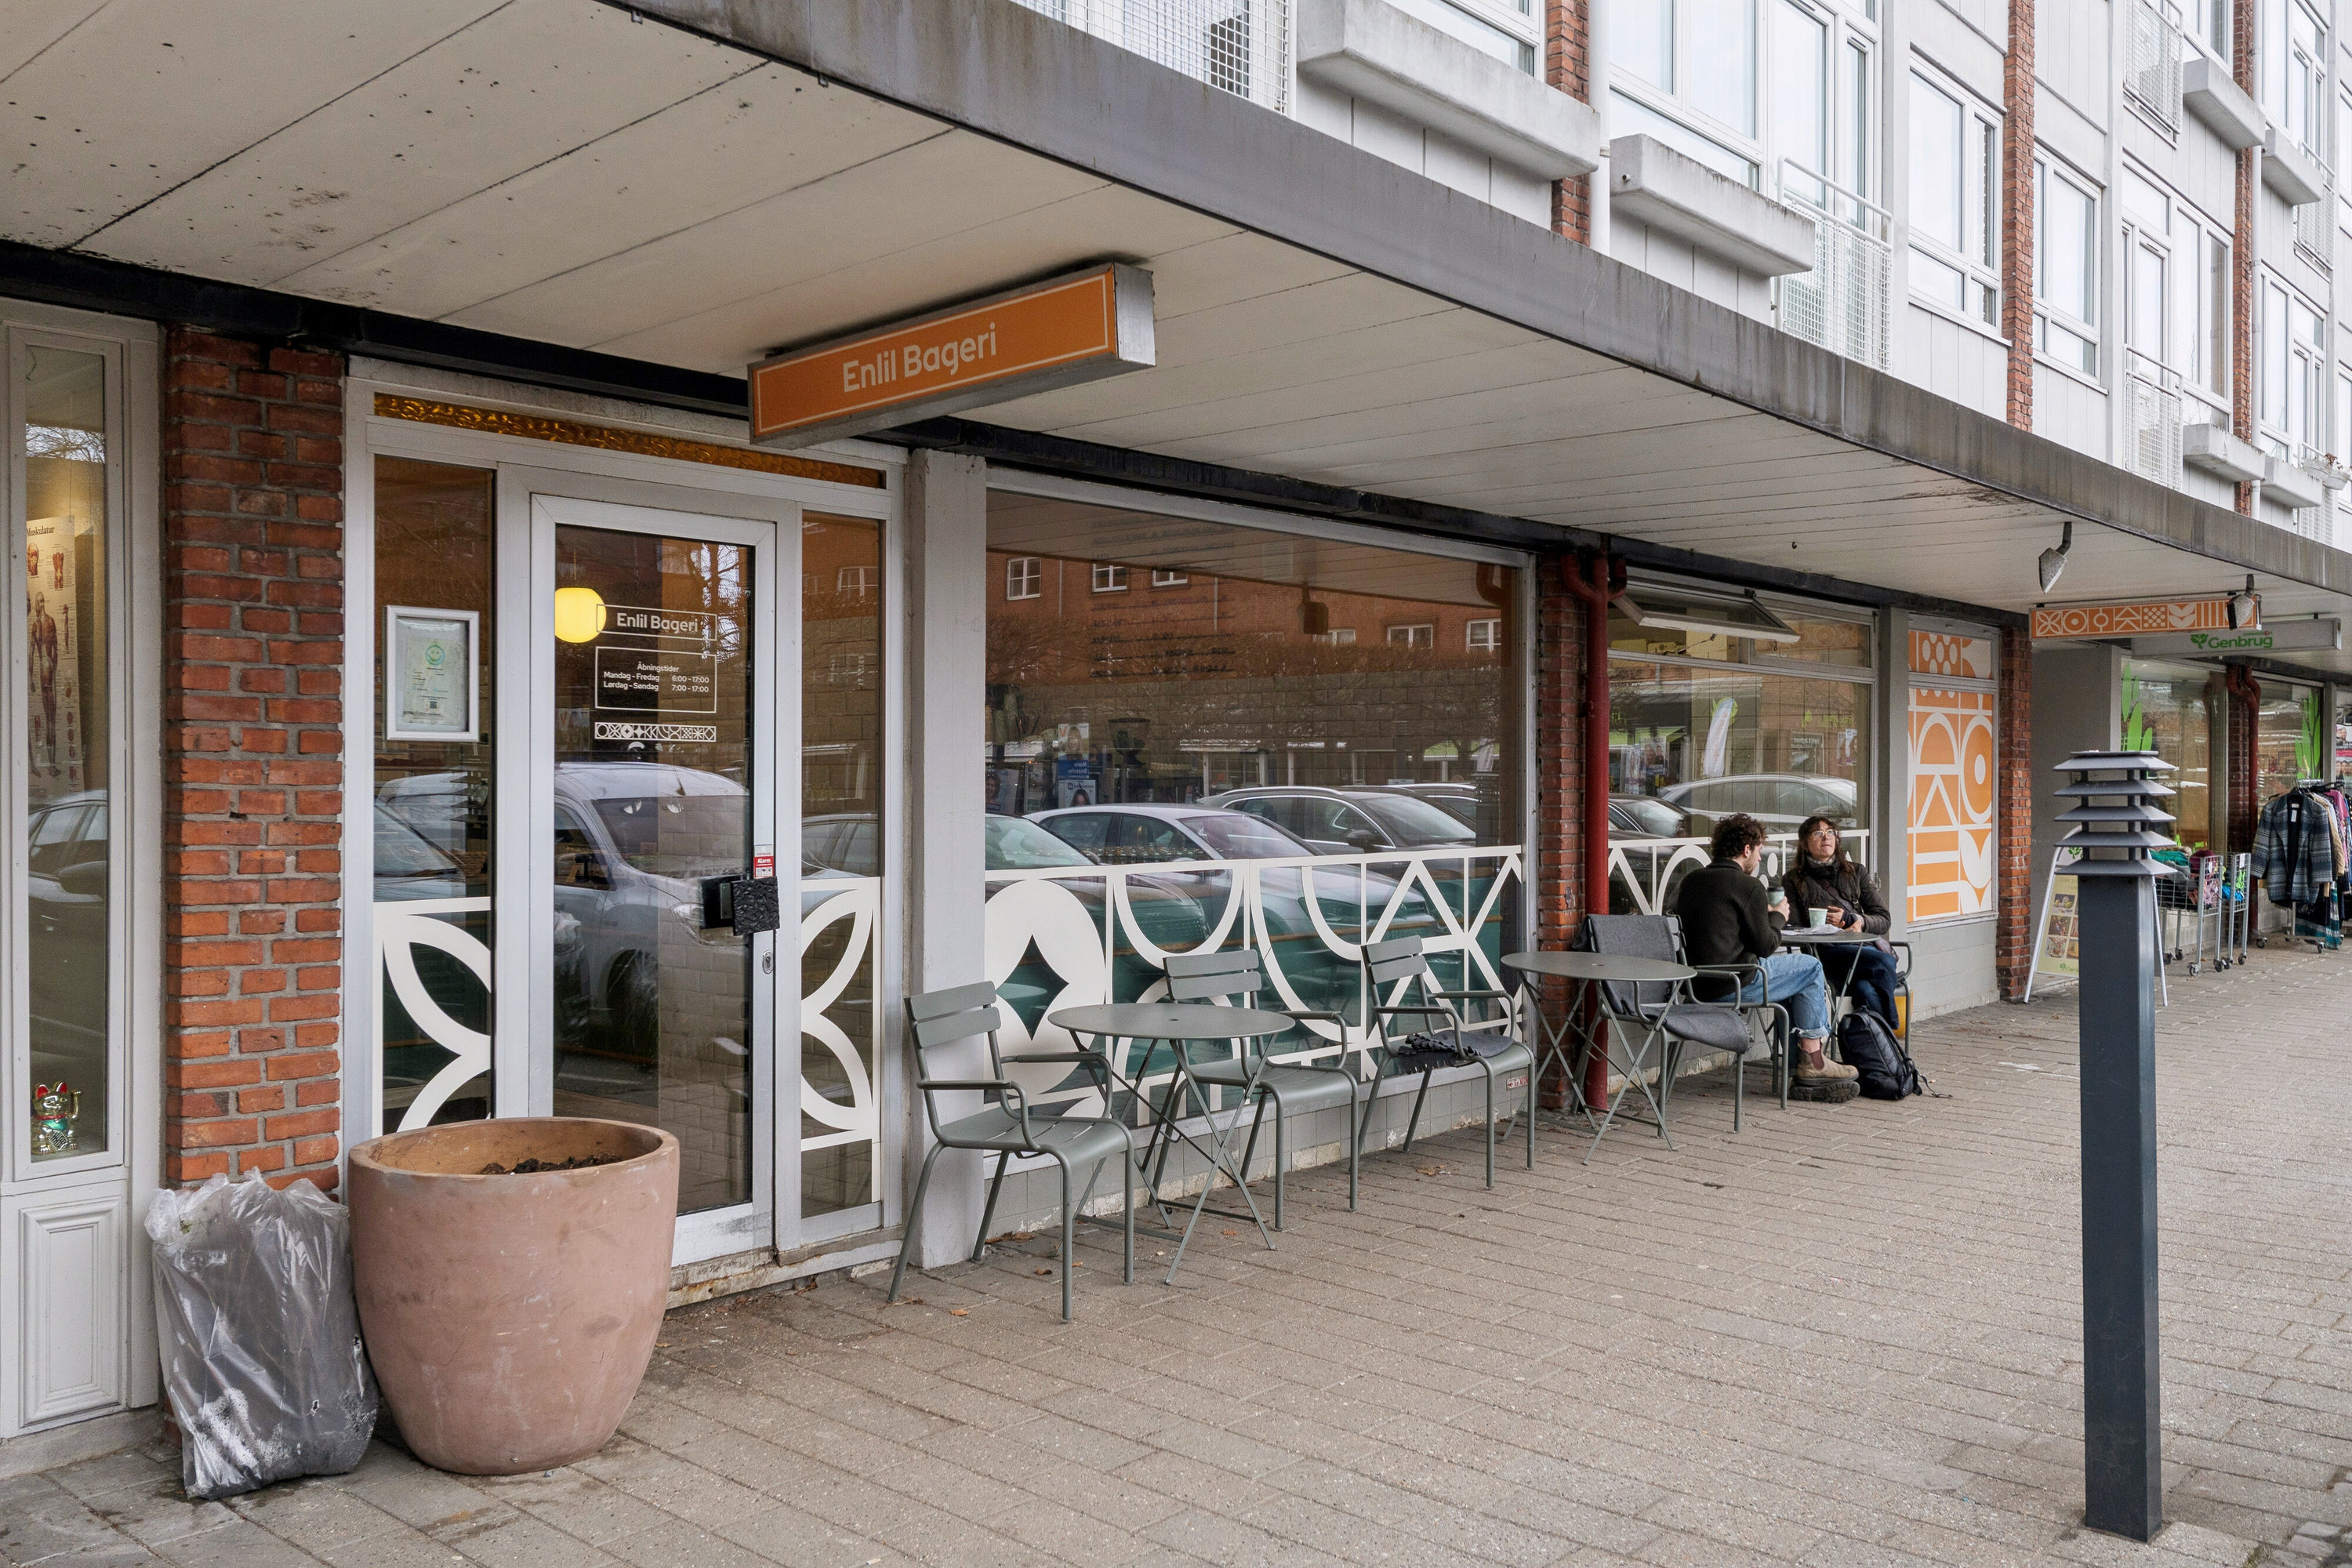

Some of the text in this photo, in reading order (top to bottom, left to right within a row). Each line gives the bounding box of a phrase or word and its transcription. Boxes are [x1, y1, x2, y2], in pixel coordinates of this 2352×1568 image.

[843, 321, 996, 393] Enlil Bageri
[617, 612, 699, 634] Enlil Bageri
[2208, 636, 2273, 649] Genbrug
[637, 661, 679, 673] Åbningstider
[603, 671, 631, 681] Mandag
[636, 673, 660, 681] Fredag
[603, 681, 628, 690] Lørdag
[633, 682, 659, 691] Søndag
